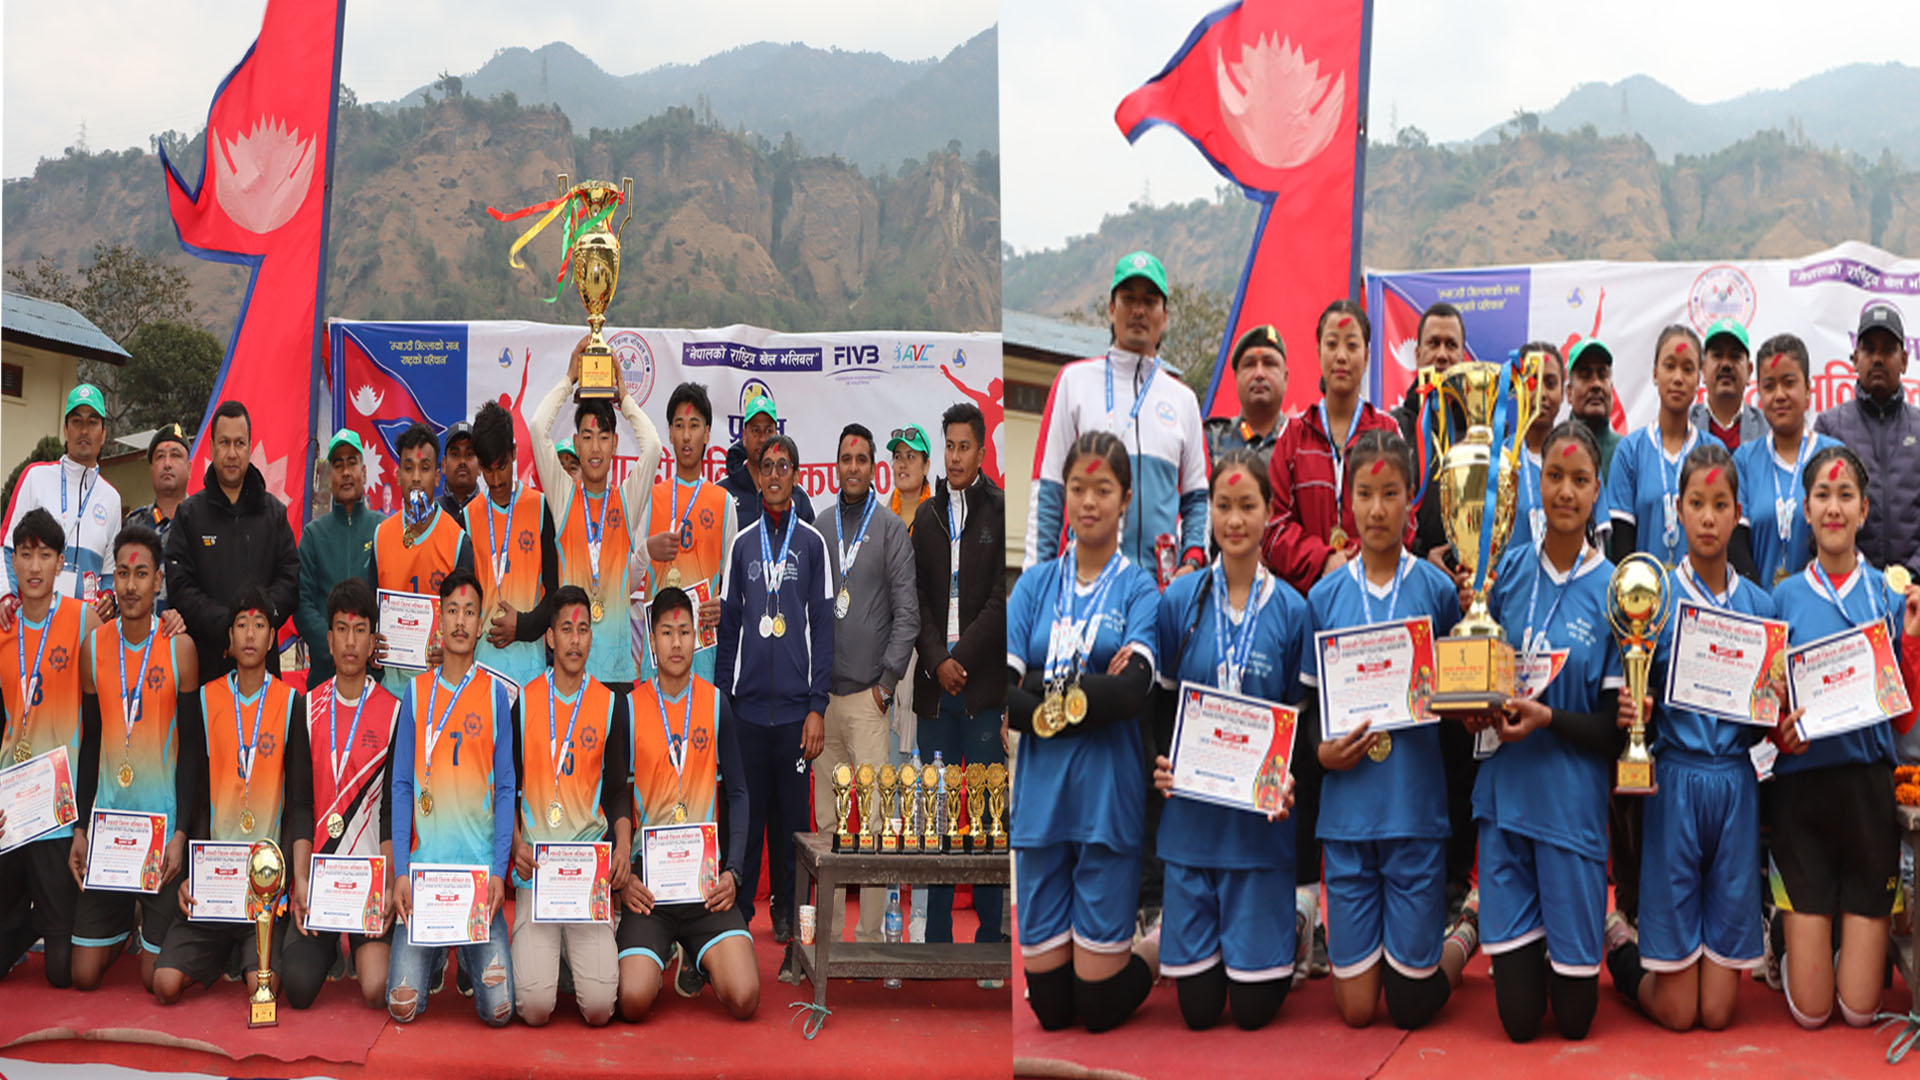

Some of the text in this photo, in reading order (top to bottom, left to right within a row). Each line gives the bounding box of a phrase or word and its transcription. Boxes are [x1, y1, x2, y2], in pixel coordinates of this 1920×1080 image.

[759, 349, 777, 366] खेल
[834, 344, 880, 366] FIVB
[902, 343, 935, 361] AVC
[681, 520, 693, 549] 6
[450, 731, 463, 766] 7
[561, 741, 574, 776] 5
